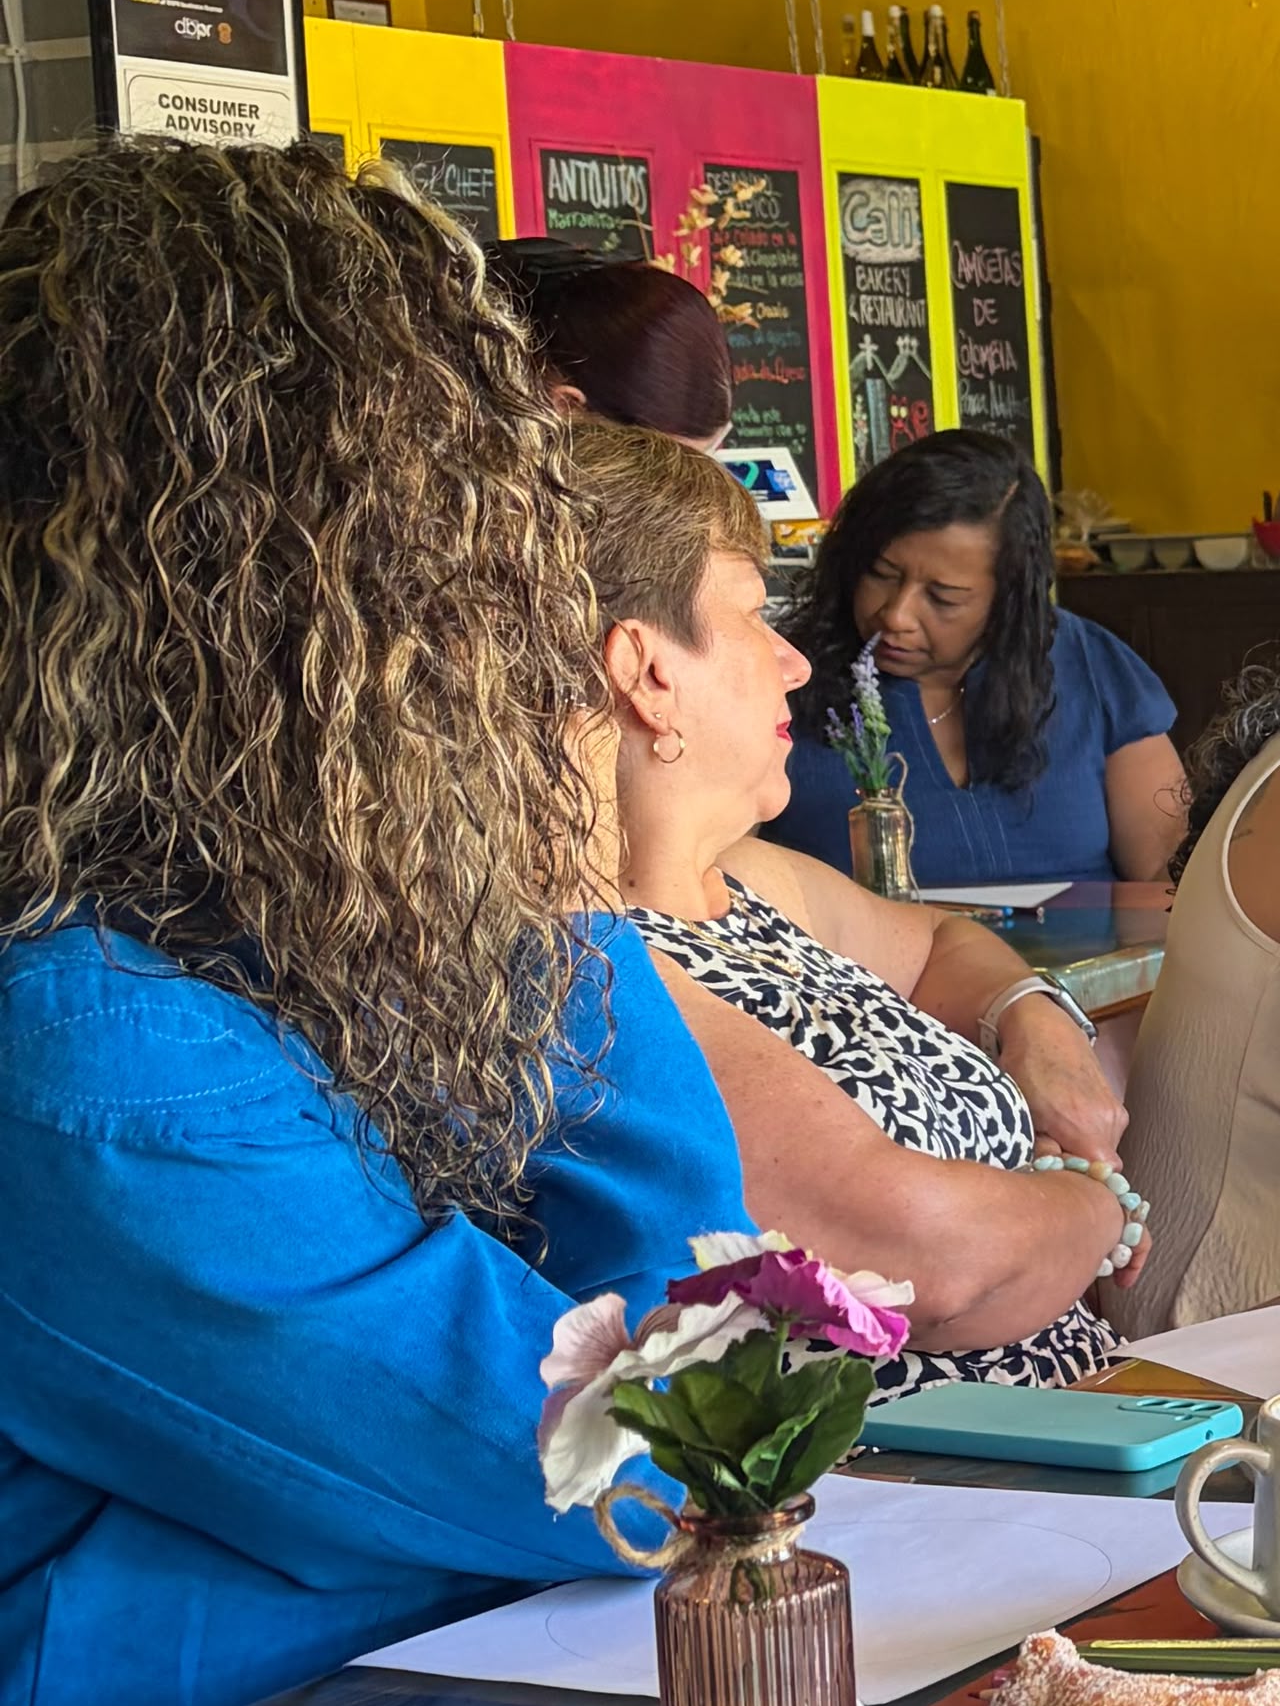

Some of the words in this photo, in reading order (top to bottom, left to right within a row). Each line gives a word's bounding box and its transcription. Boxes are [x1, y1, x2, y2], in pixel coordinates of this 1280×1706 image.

[174, 17, 213, 41] dbpr
[158, 93, 260, 120] CONSUMER
[166, 114, 256, 138] ADVISORY
[443, 163, 496, 199] CHEF
[547, 156, 648, 216] ANTOJITOS
[842, 187, 914, 249] Cali
[854, 264, 912, 298] BAKERY
[859, 295, 927, 329] RESTAURANT
[973, 297, 998, 327] DE
